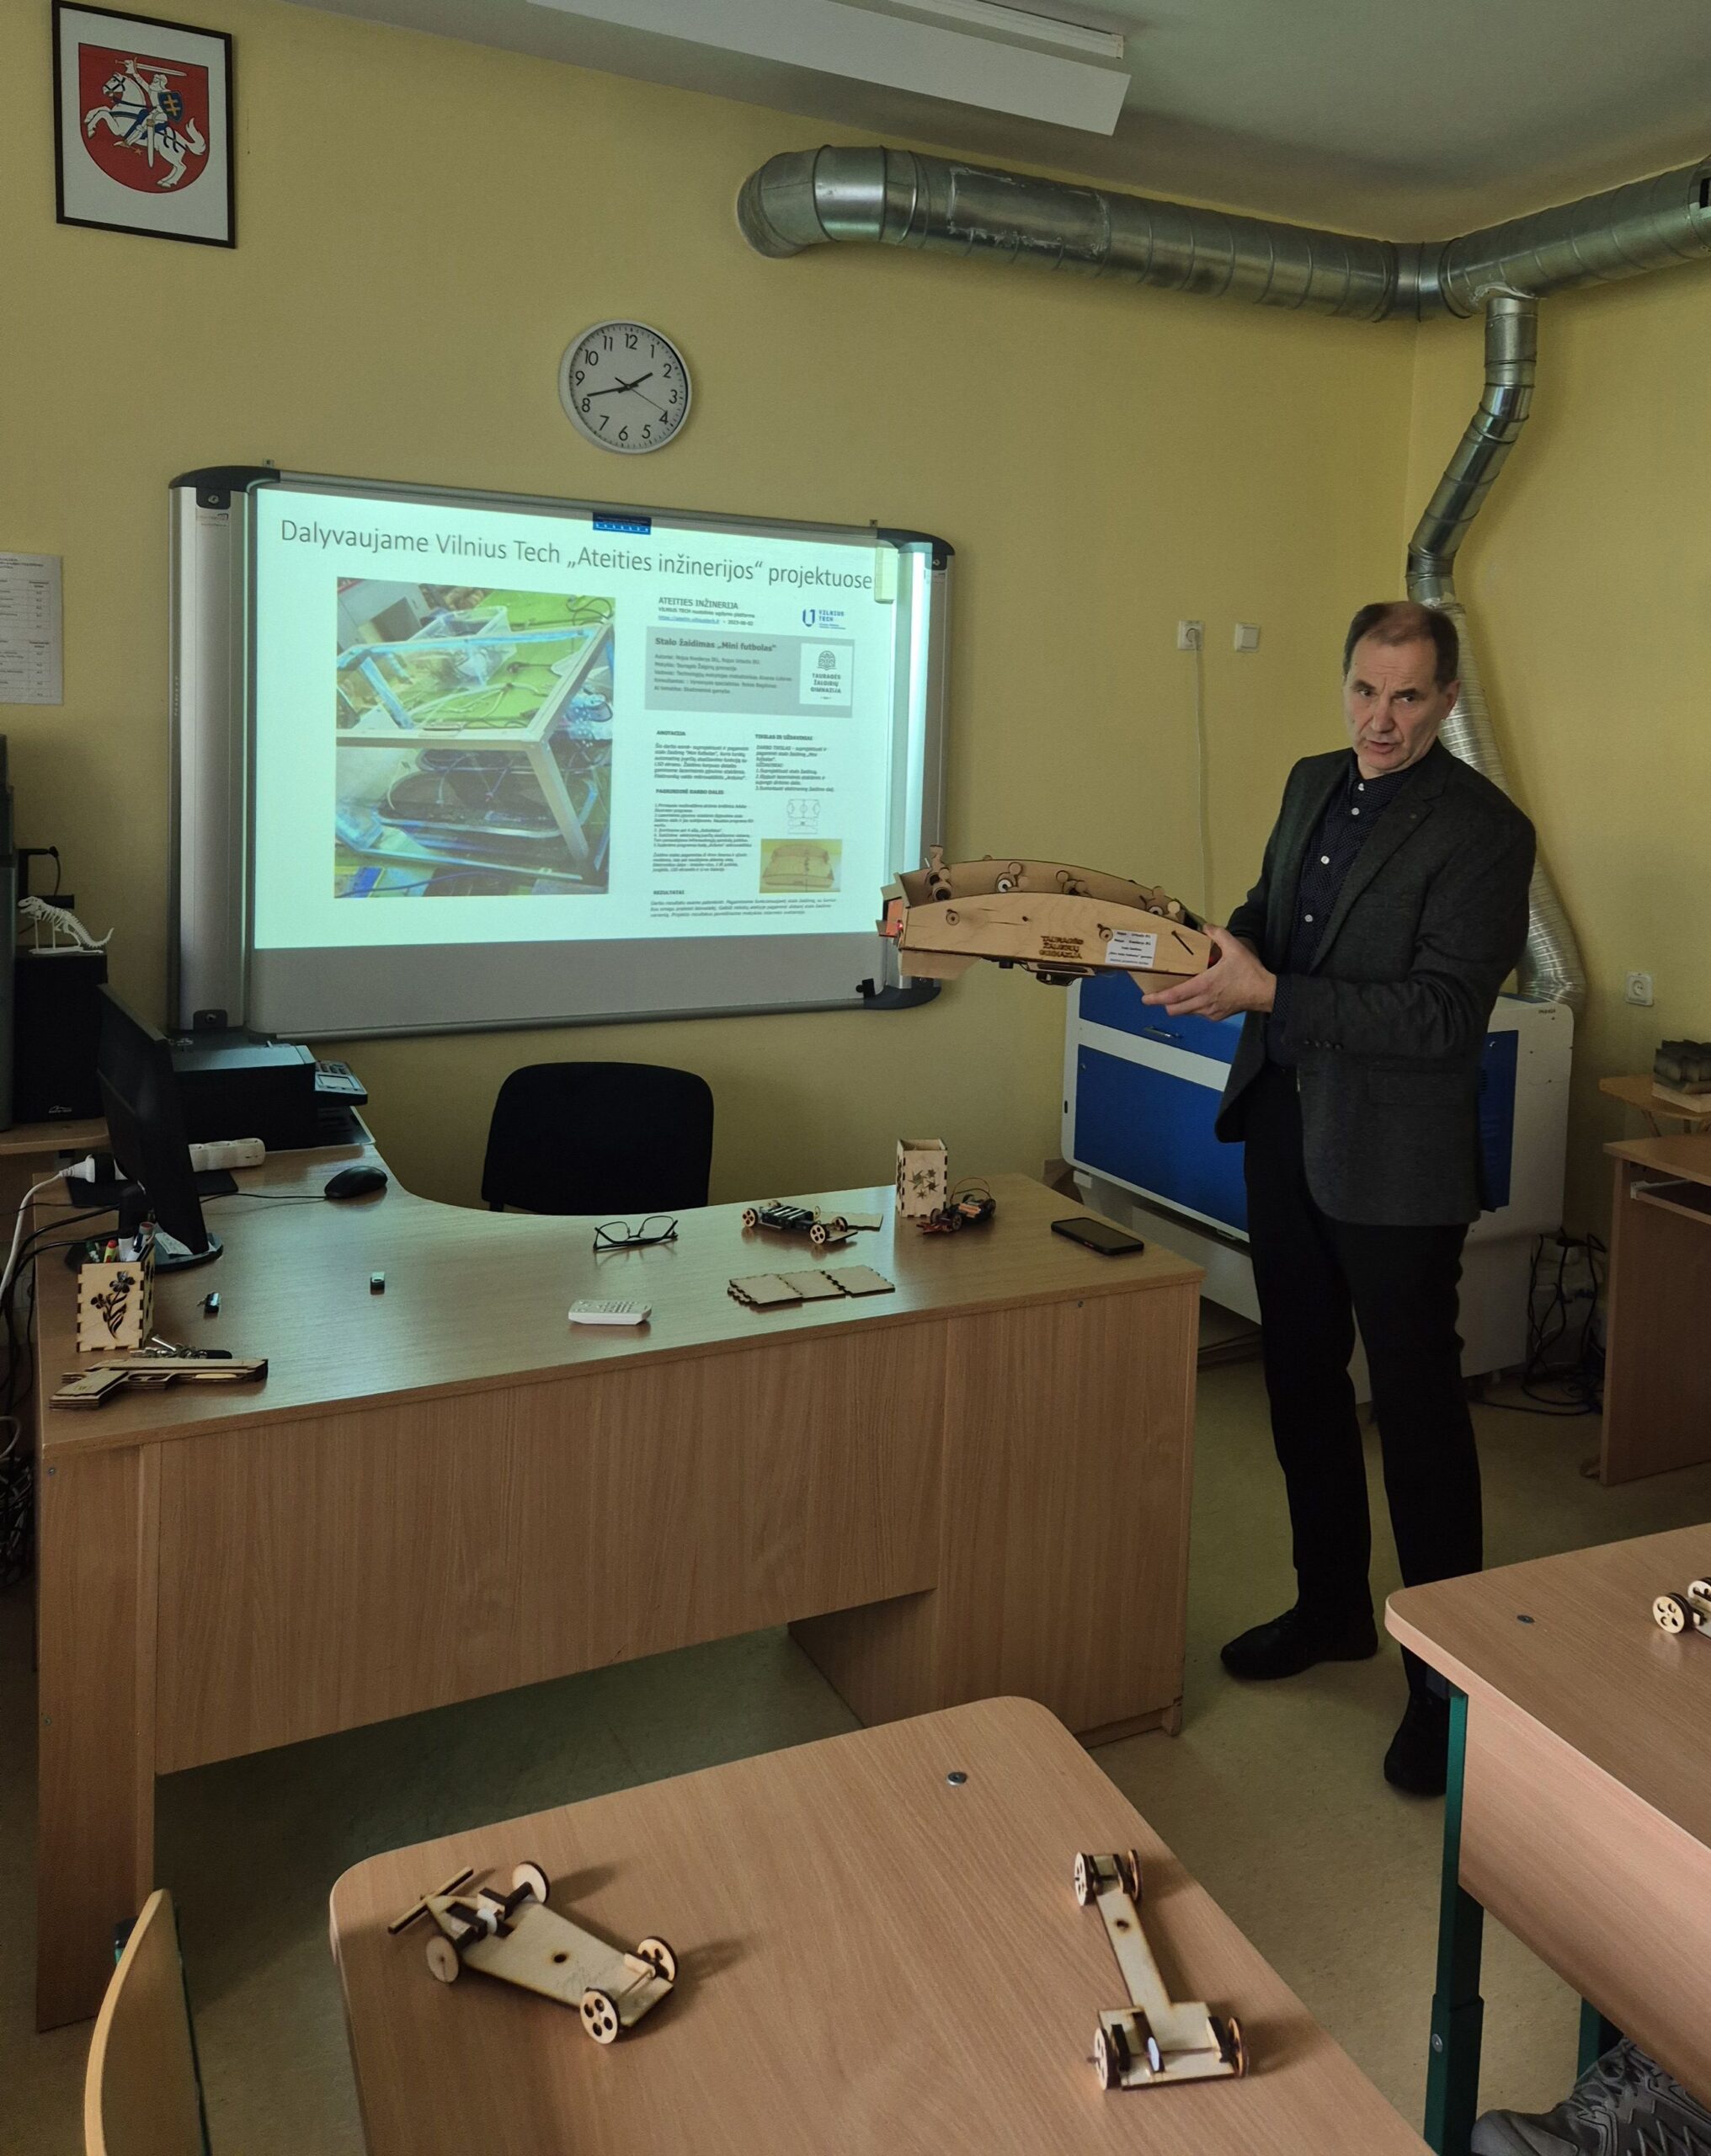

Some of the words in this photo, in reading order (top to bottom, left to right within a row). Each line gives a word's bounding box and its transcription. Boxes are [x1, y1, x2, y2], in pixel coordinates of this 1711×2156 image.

[603, 335, 613, 351] 11
[625, 334, 638, 350] 12
[584, 349, 599, 366] 10
[650, 344, 655, 359] 1
[663, 363, 672, 378] 2
[575, 371, 585, 386] 9
[669, 389, 678, 404] 3
[581, 398, 590, 413] 8
[600, 414, 610, 431] 7
[658, 410, 669, 424] 4
[618, 425, 628, 441] 6
[641, 424, 651, 439] 5
[281, 520, 429, 553] Dalyvaujame
[435, 533, 506, 560] Vilnius
[513, 540, 561, 563] Tech
[567, 547, 652, 572] „Ateities
[768, 565, 872, 590] projektuose
[658, 596, 694, 607] ATEITIES
[696, 598, 738, 610] INŽINERIJA
[655, 638, 676, 646] Stalo
[679, 638, 715, 648] žaidimas
